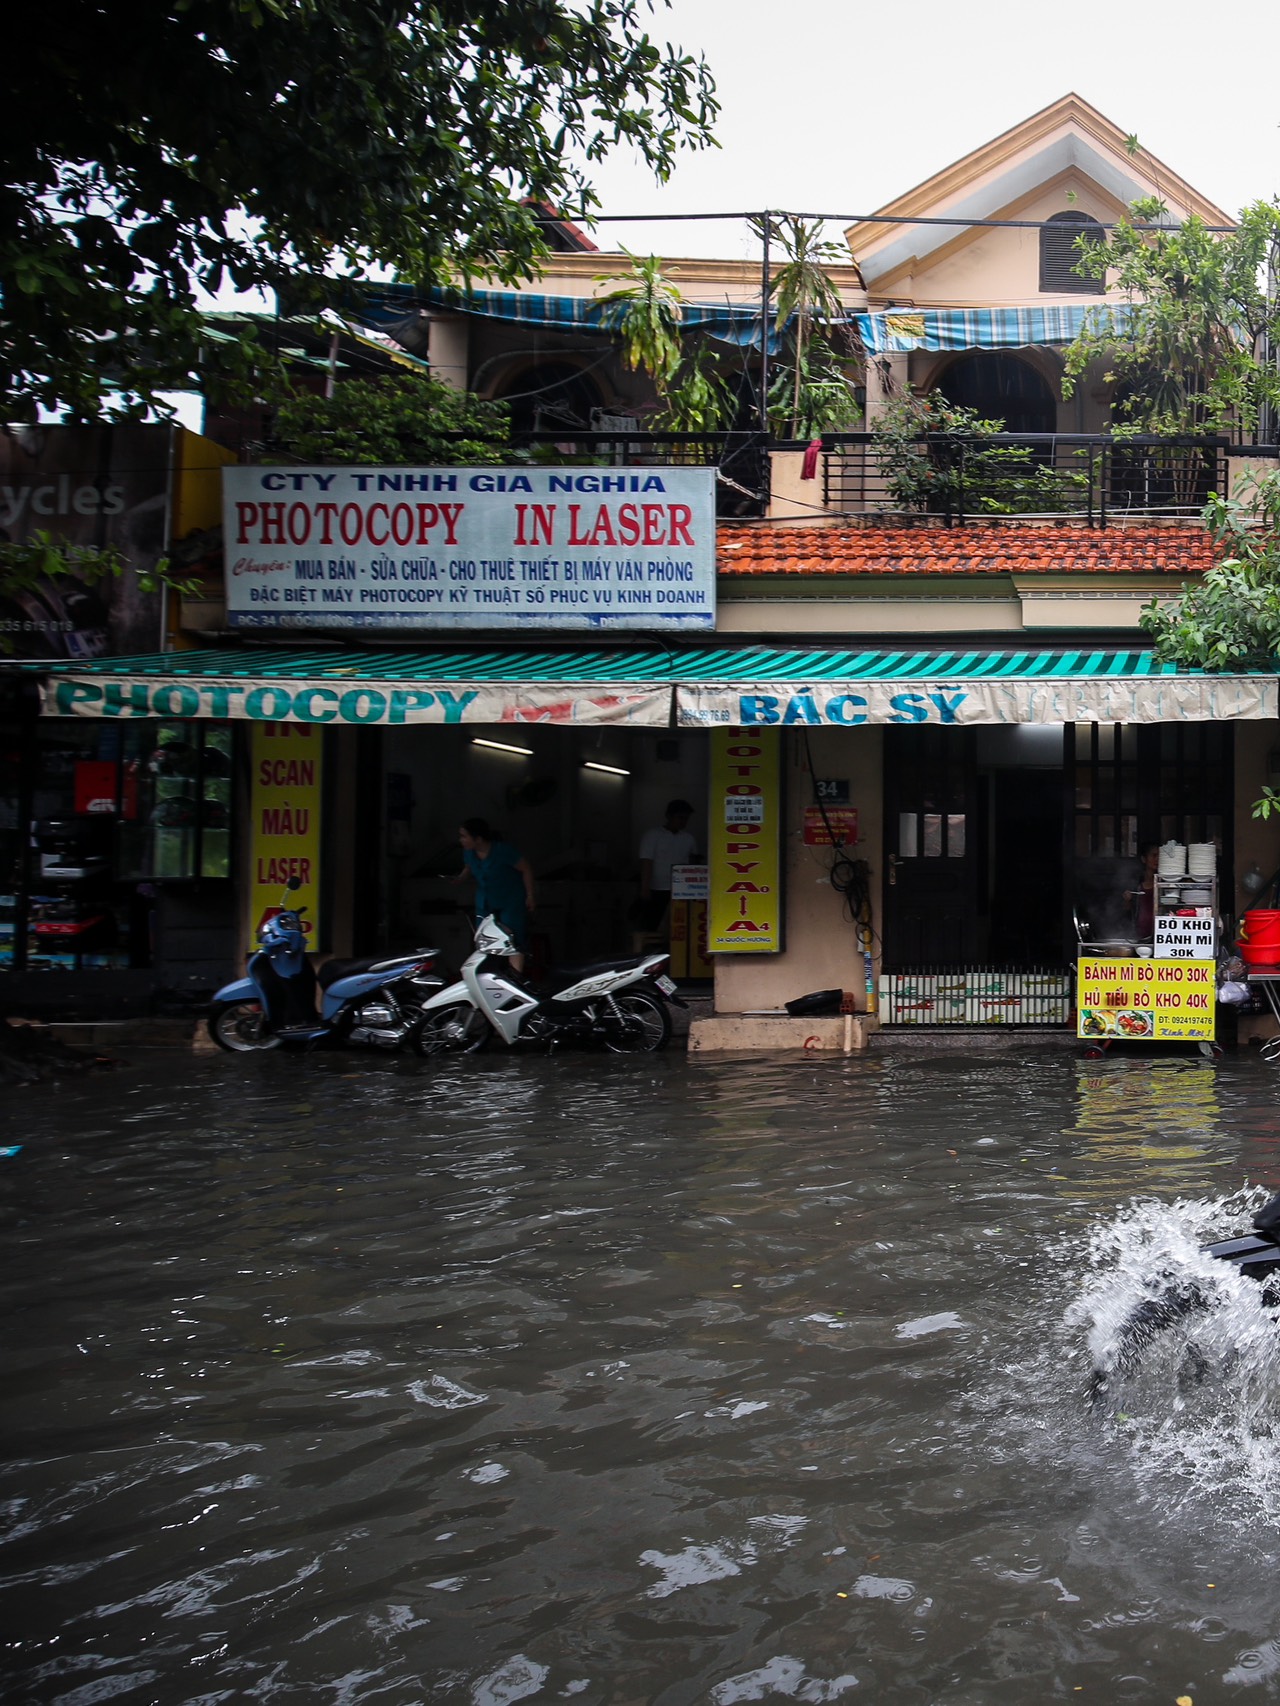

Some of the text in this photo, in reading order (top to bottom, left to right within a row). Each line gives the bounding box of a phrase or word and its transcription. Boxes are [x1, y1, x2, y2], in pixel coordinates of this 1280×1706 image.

[261, 473, 666, 493] CTY TNHH GIA NGHIA
[235, 501, 695, 546] PHOTOCOPY IN LASER
[295, 559, 324, 580] MUA
[328, 555, 356, 580] BÁN
[371, 553, 397, 580] SỬA
[401, 556, 437, 581] CHỮA
[449, 560, 475, 580] CHO
[480, 557, 515, 580] THUÊ
[519, 554, 559, 581] THIẾT
[564, 560, 578, 583] BỊ
[582, 556, 611, 581] MÁY
[616, 558, 642, 581] VĂN
[648, 556, 692, 581] PHÒNG
[250, 585, 279, 604] ĐẶC
[284, 586, 317, 604] BIỆT
[322, 586, 353, 602] MÁY
[360, 588, 443, 602] PHOTOCOPY
[473, 587, 521, 605] THUẬT
[526, 585, 545, 603] SỐ
[550, 589, 589, 606] PHỤC
[593, 589, 612, 606] VỤ
[618, 590, 651, 603] KINH
[657, 590, 705, 603] DOANH
[56, 682, 479, 723] PHOTOCOPY
[739, 686, 969, 725] BÁC SỸ
[259, 759, 314, 786] SCAN
[816, 781, 838, 796] 34
[262, 801, 309, 835] MÀU
[258, 857, 310, 884] LASER
[1158, 917, 1211, 931] BÒ KHO
[1156, 933, 1212, 945] BÁNH MÌ
[1170, 949, 1195, 957] 30K
[1084, 962, 1209, 982] BÁNH MÌ BÒ KHO 30K
[1084, 986, 1209, 1008] HỦ TIẾU BÒ KHO 40K
[1158, 1016, 1213, 1024] ĐT: 0924197476
